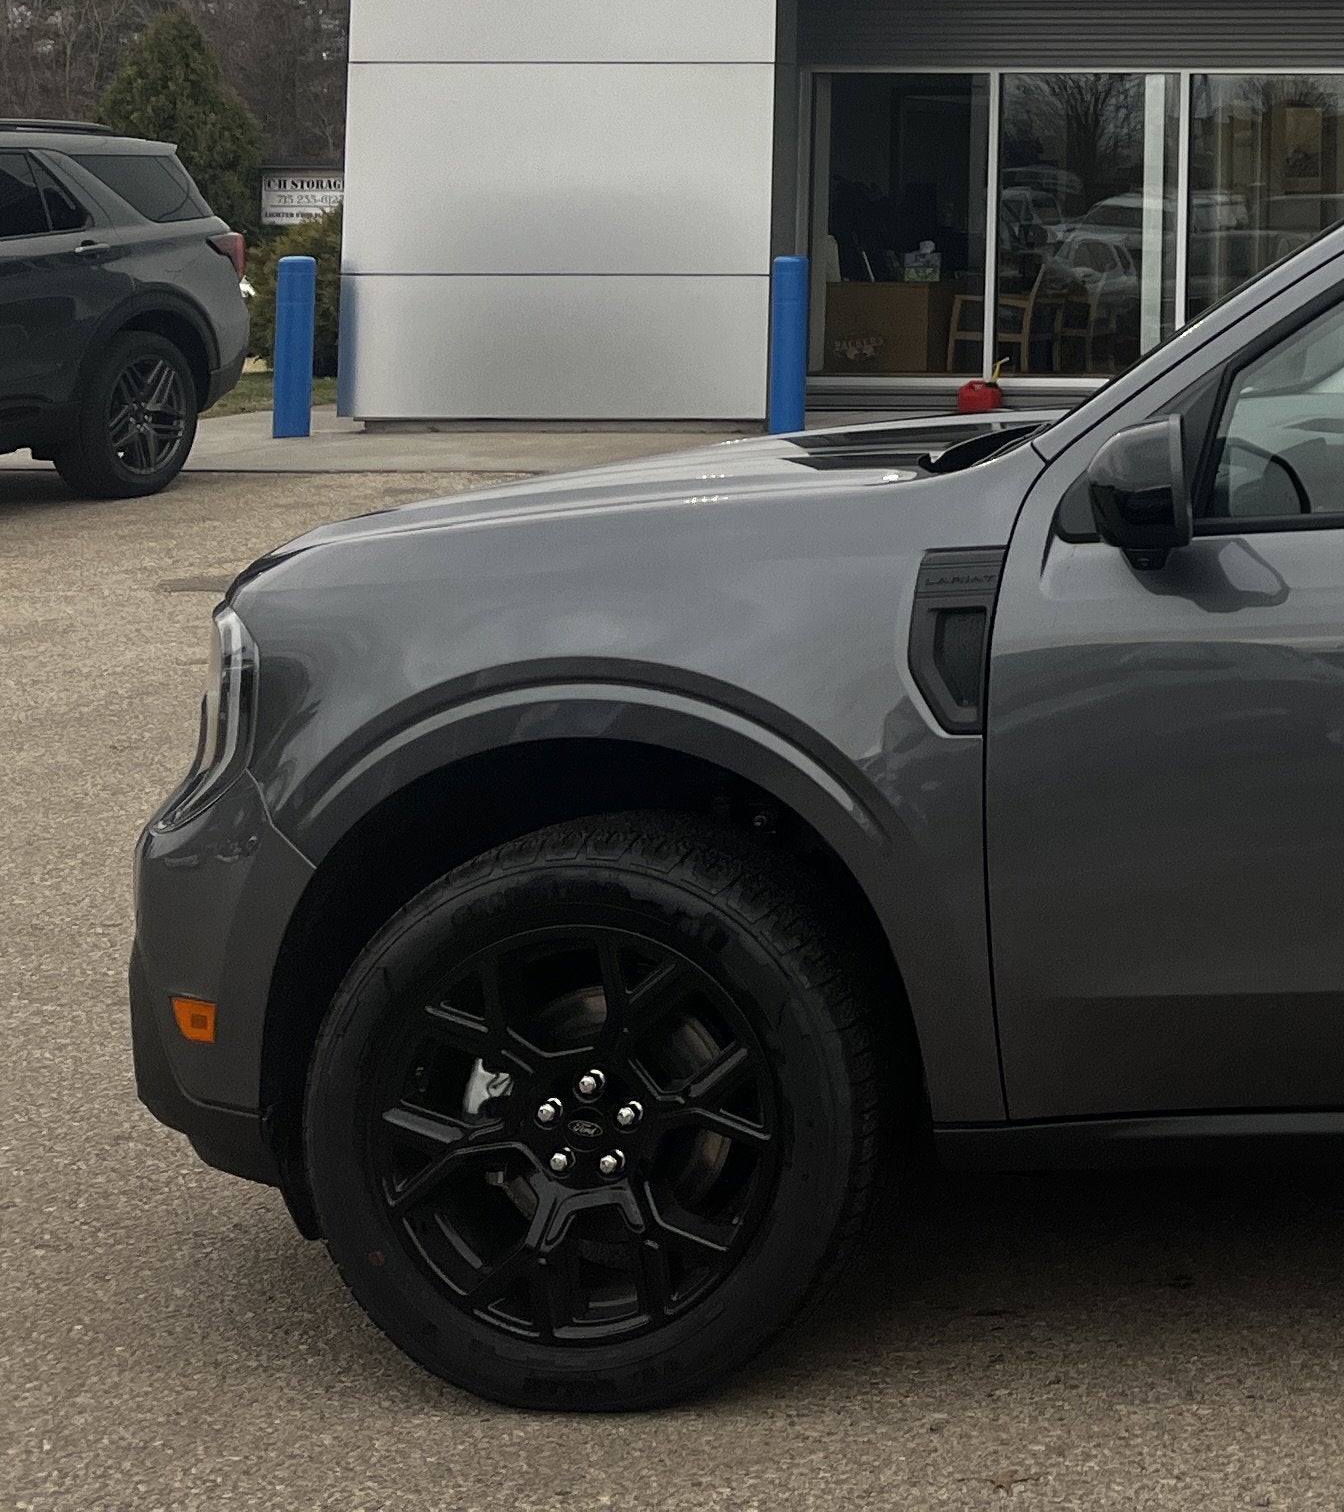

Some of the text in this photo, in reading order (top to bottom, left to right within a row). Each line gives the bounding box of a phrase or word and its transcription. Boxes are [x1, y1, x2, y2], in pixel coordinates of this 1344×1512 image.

[291, 179, 344, 190] STORAG
[925, 574, 997, 586] LARIAT
[572, 1121, 598, 1136] Ford
